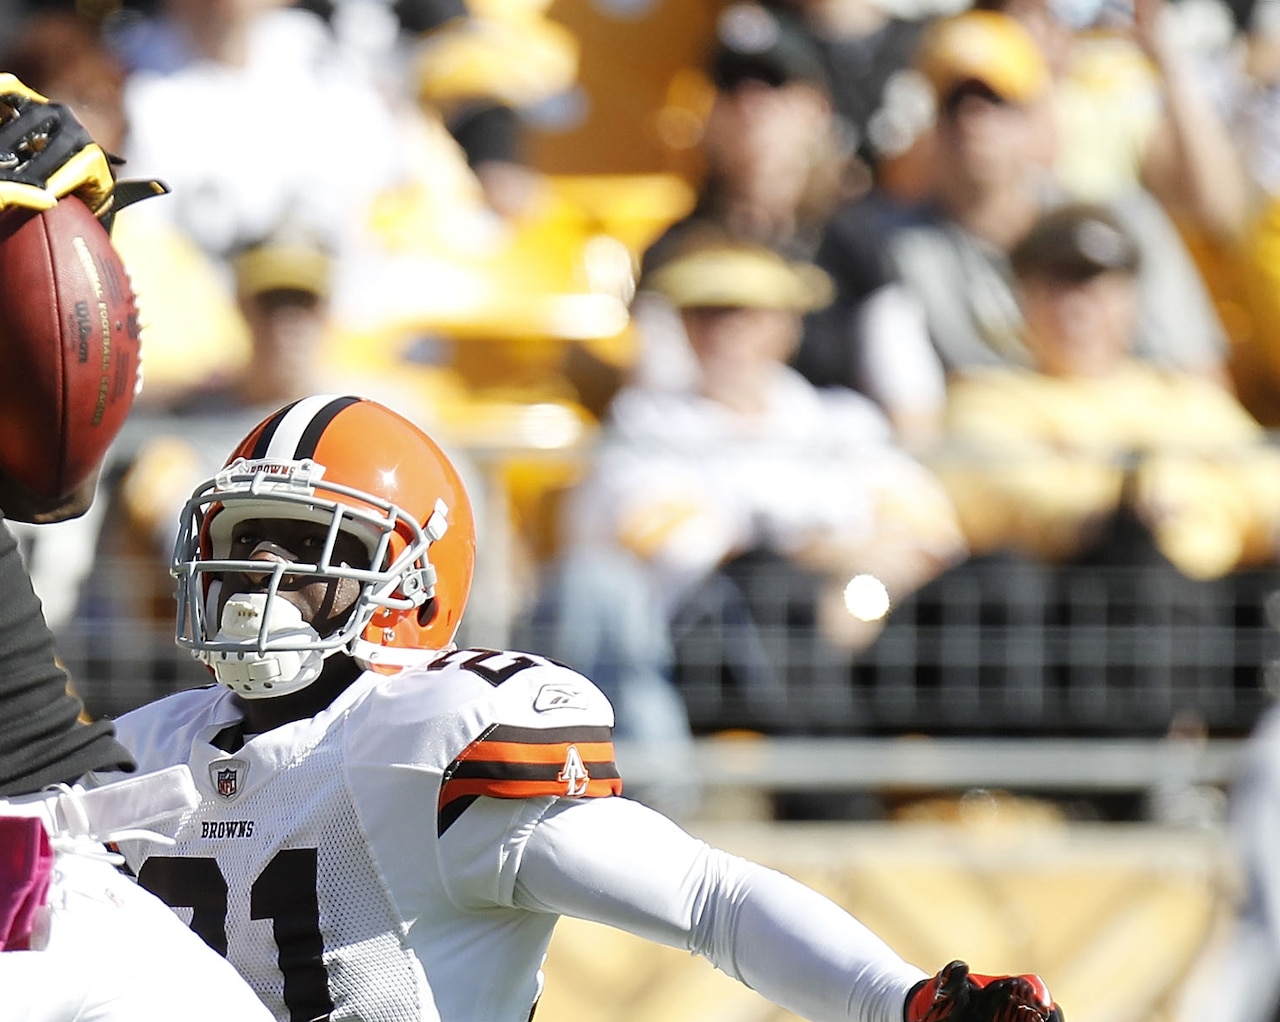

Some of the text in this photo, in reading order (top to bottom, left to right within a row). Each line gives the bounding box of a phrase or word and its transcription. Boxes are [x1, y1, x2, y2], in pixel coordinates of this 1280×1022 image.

[75, 300, 91, 363] Wilson
[99, 302, 111, 371] FOOTBALL
[92, 375, 111, 426] LEAGUE
[219, 780, 236, 795] NFL
[201, 820, 255, 839] BROWNS
